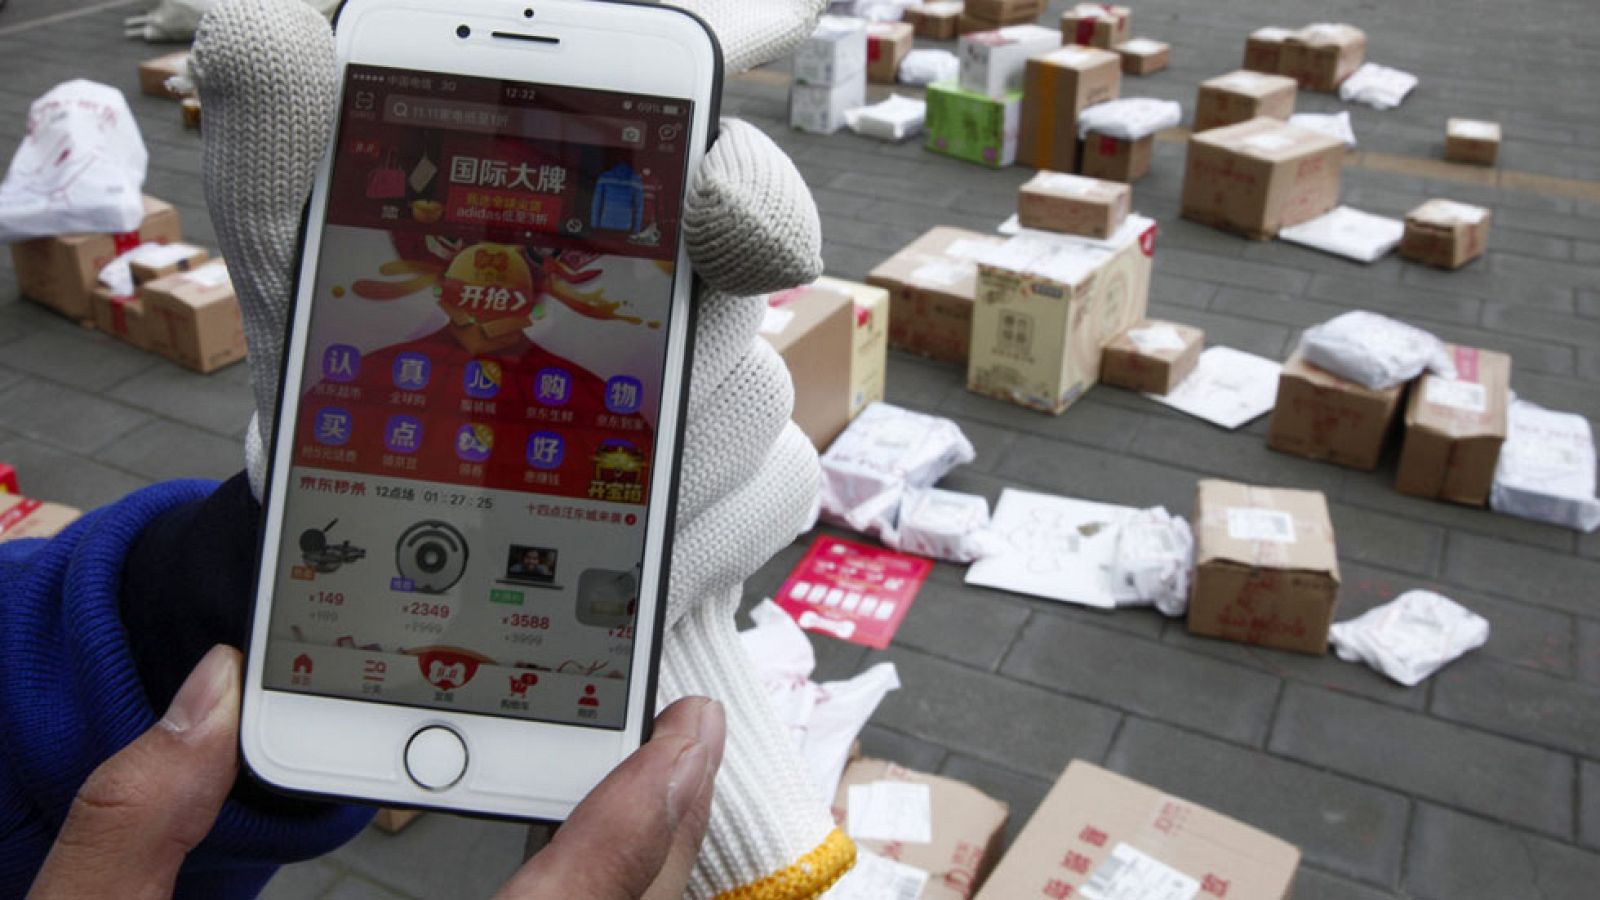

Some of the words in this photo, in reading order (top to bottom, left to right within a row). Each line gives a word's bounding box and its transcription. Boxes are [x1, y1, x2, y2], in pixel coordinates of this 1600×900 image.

[505, 87, 536, 100] 12:32
[450, 155, 568, 194] 国际大牌
[329, 349, 352, 377] 认
[398, 357, 425, 385] 真
[539, 372, 566, 401] 购
[610, 380, 638, 409] 物
[319, 413, 347, 440] 买
[390, 420, 417, 449] 点
[532, 435, 561, 464] 好
[299, 475, 367, 498] 京东秒杀
